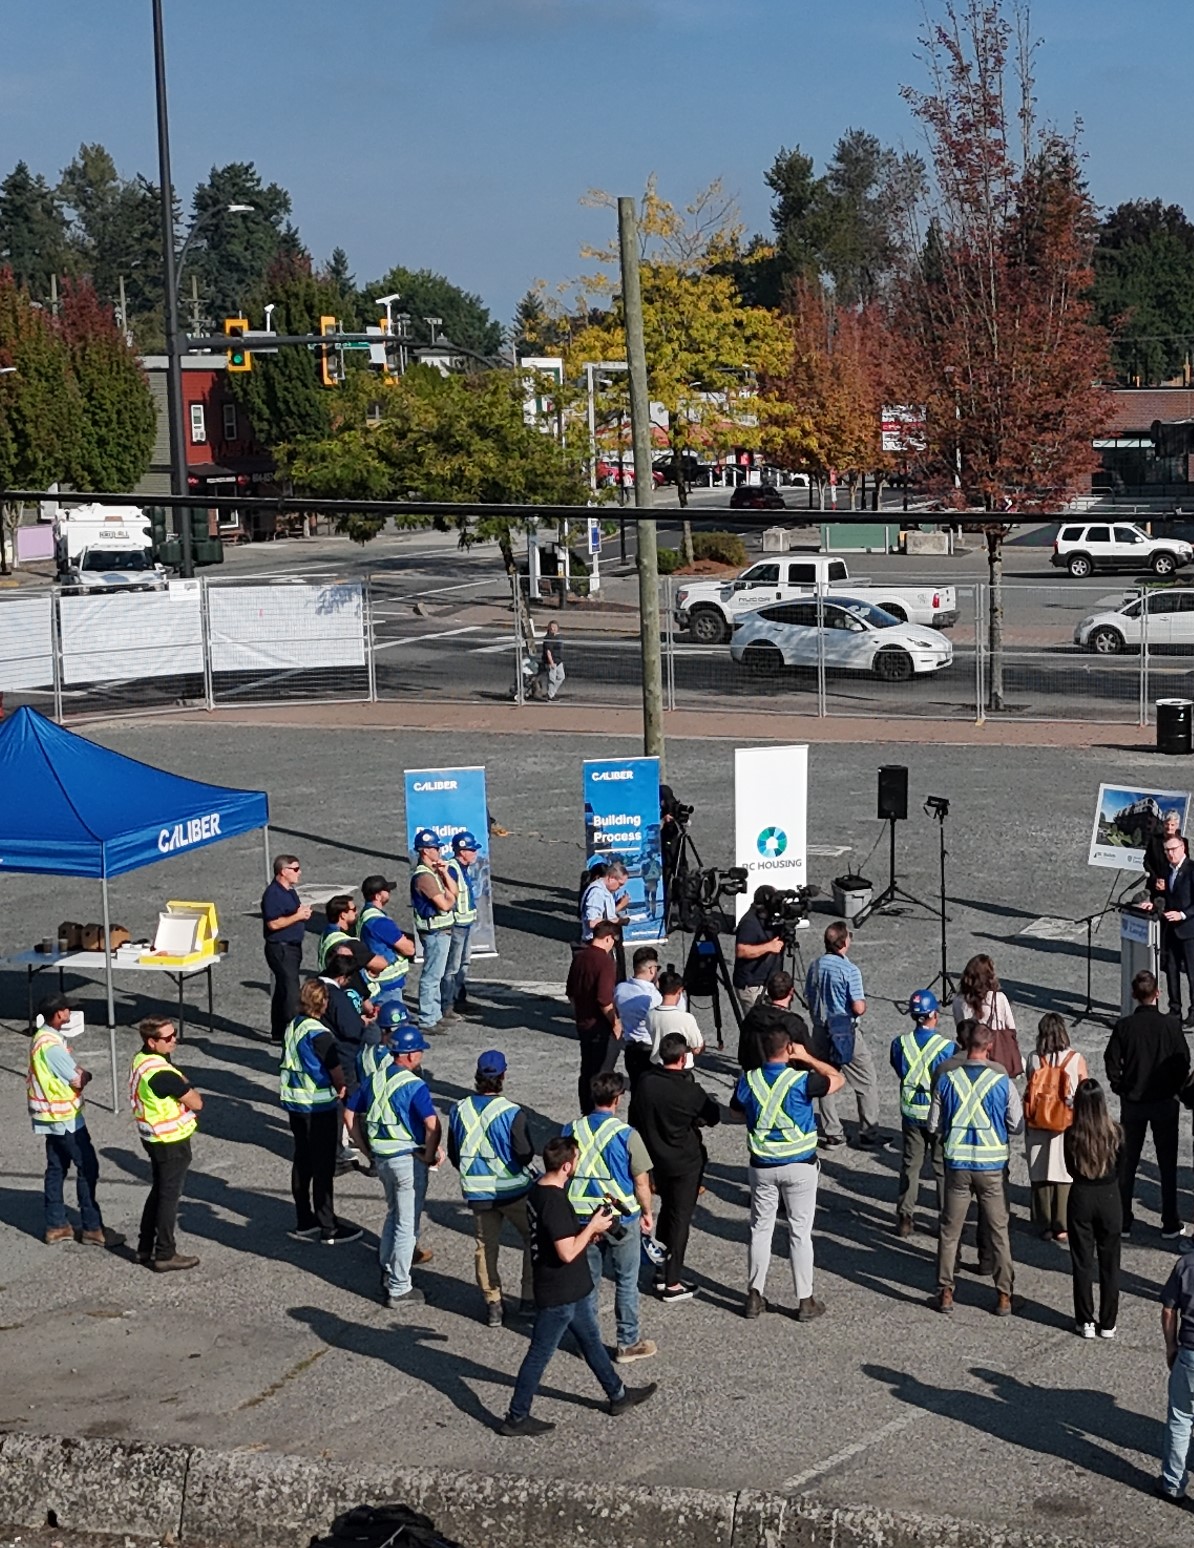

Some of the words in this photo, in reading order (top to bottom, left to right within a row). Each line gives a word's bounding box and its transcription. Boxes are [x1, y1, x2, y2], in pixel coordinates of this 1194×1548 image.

[592, 770, 634, 781] CALIBER
[413, 780, 458, 792] CALIBER
[593, 814, 641, 827] Building
[158, 813, 222, 853] CALIBER
[593, 832, 642, 843] Process
[758, 859, 802, 870] HOUSING
